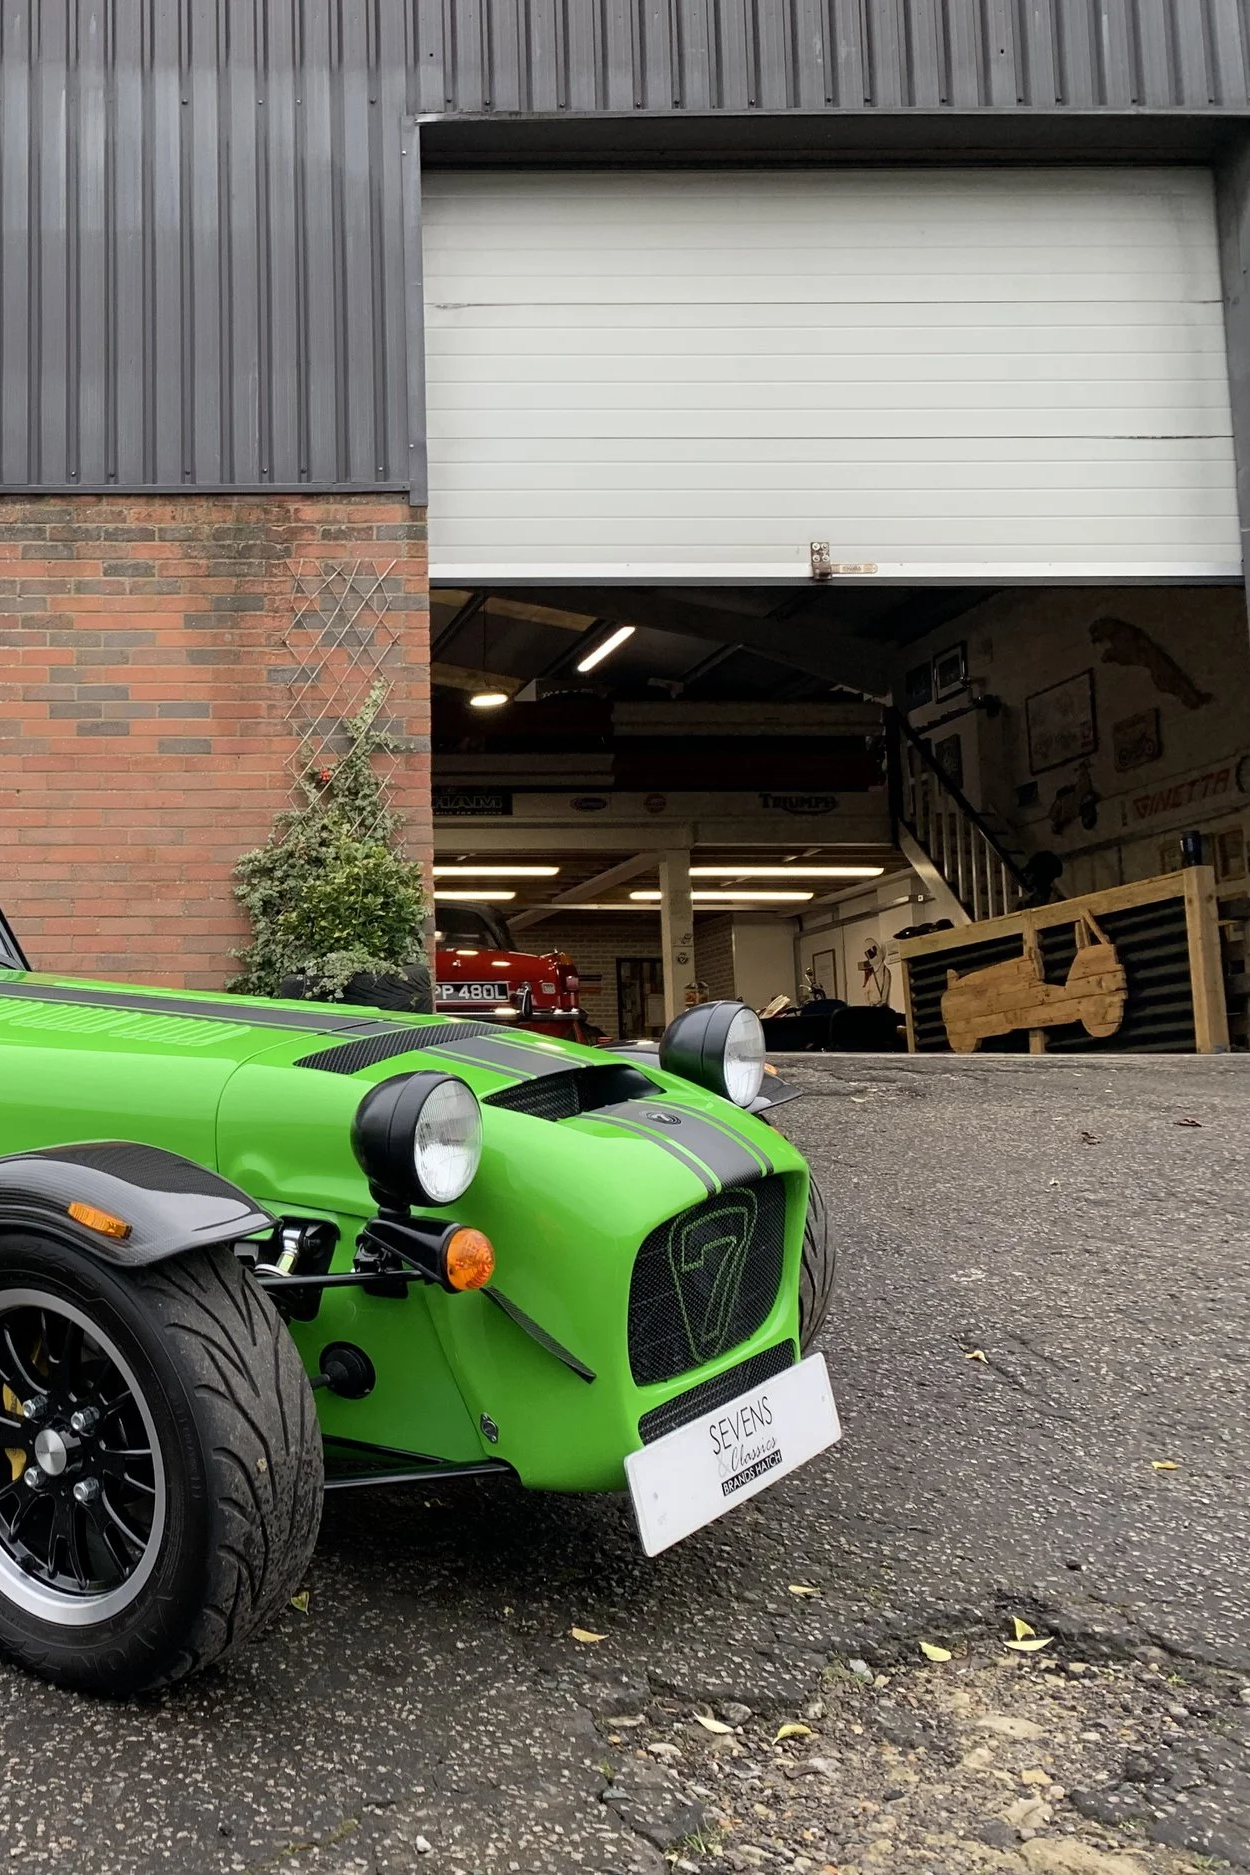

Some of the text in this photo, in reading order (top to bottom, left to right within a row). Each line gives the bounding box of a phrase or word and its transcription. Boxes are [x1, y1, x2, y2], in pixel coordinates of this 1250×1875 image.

[458, 984, 507, 1000] 480L
[681, 1206, 749, 1342] 7
[709, 1396, 772, 1455] SEVENS
[722, 1450, 782, 1495] BRANDS HATCH
[731, 1437, 776, 1471] Classics
